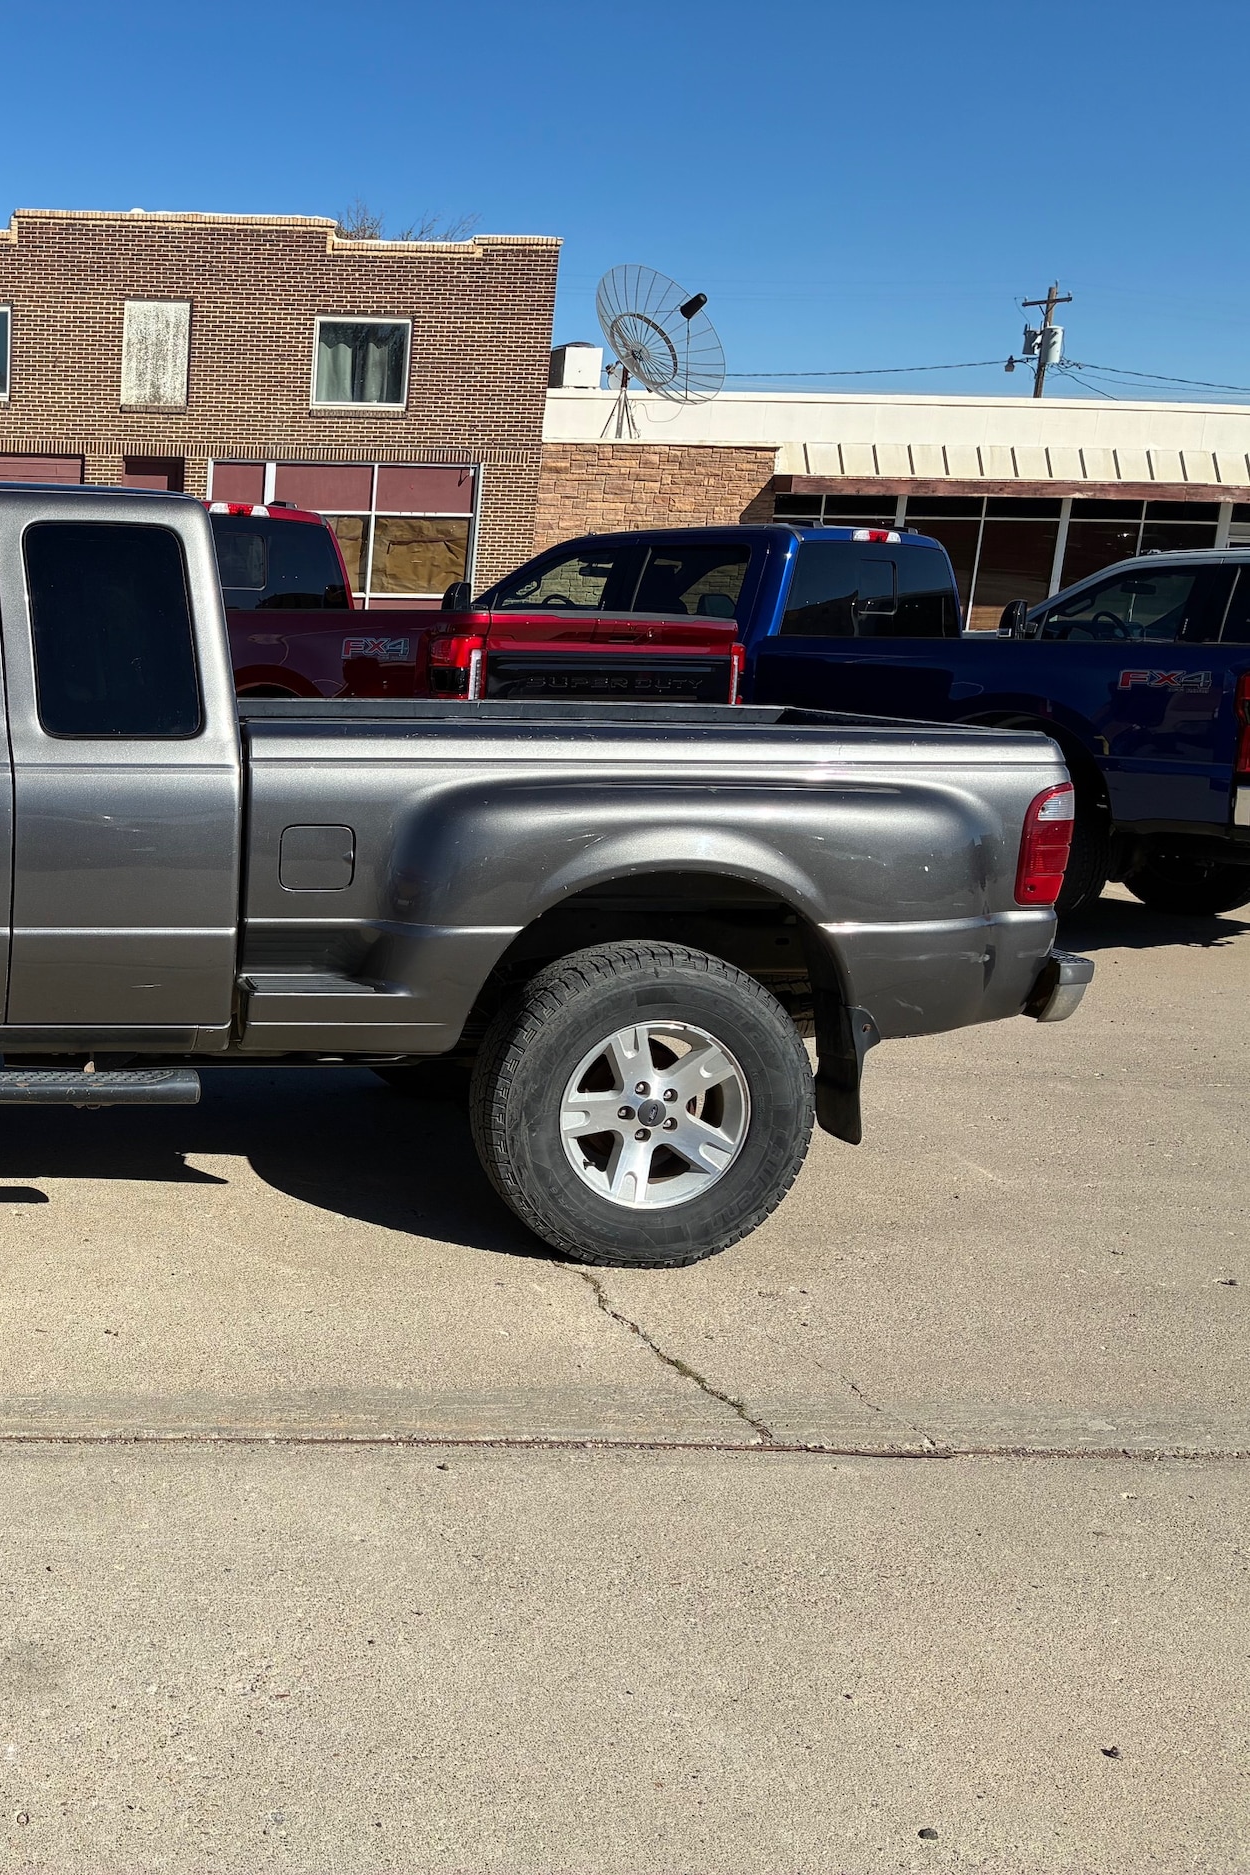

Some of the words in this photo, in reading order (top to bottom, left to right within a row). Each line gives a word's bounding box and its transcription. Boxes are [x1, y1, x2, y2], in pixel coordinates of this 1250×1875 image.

[341, 637, 409, 659] FX4
[526, 676, 629, 689] SUPER
[634, 678, 703, 690] DUTY
[1118, 669, 1212, 690] FX4
